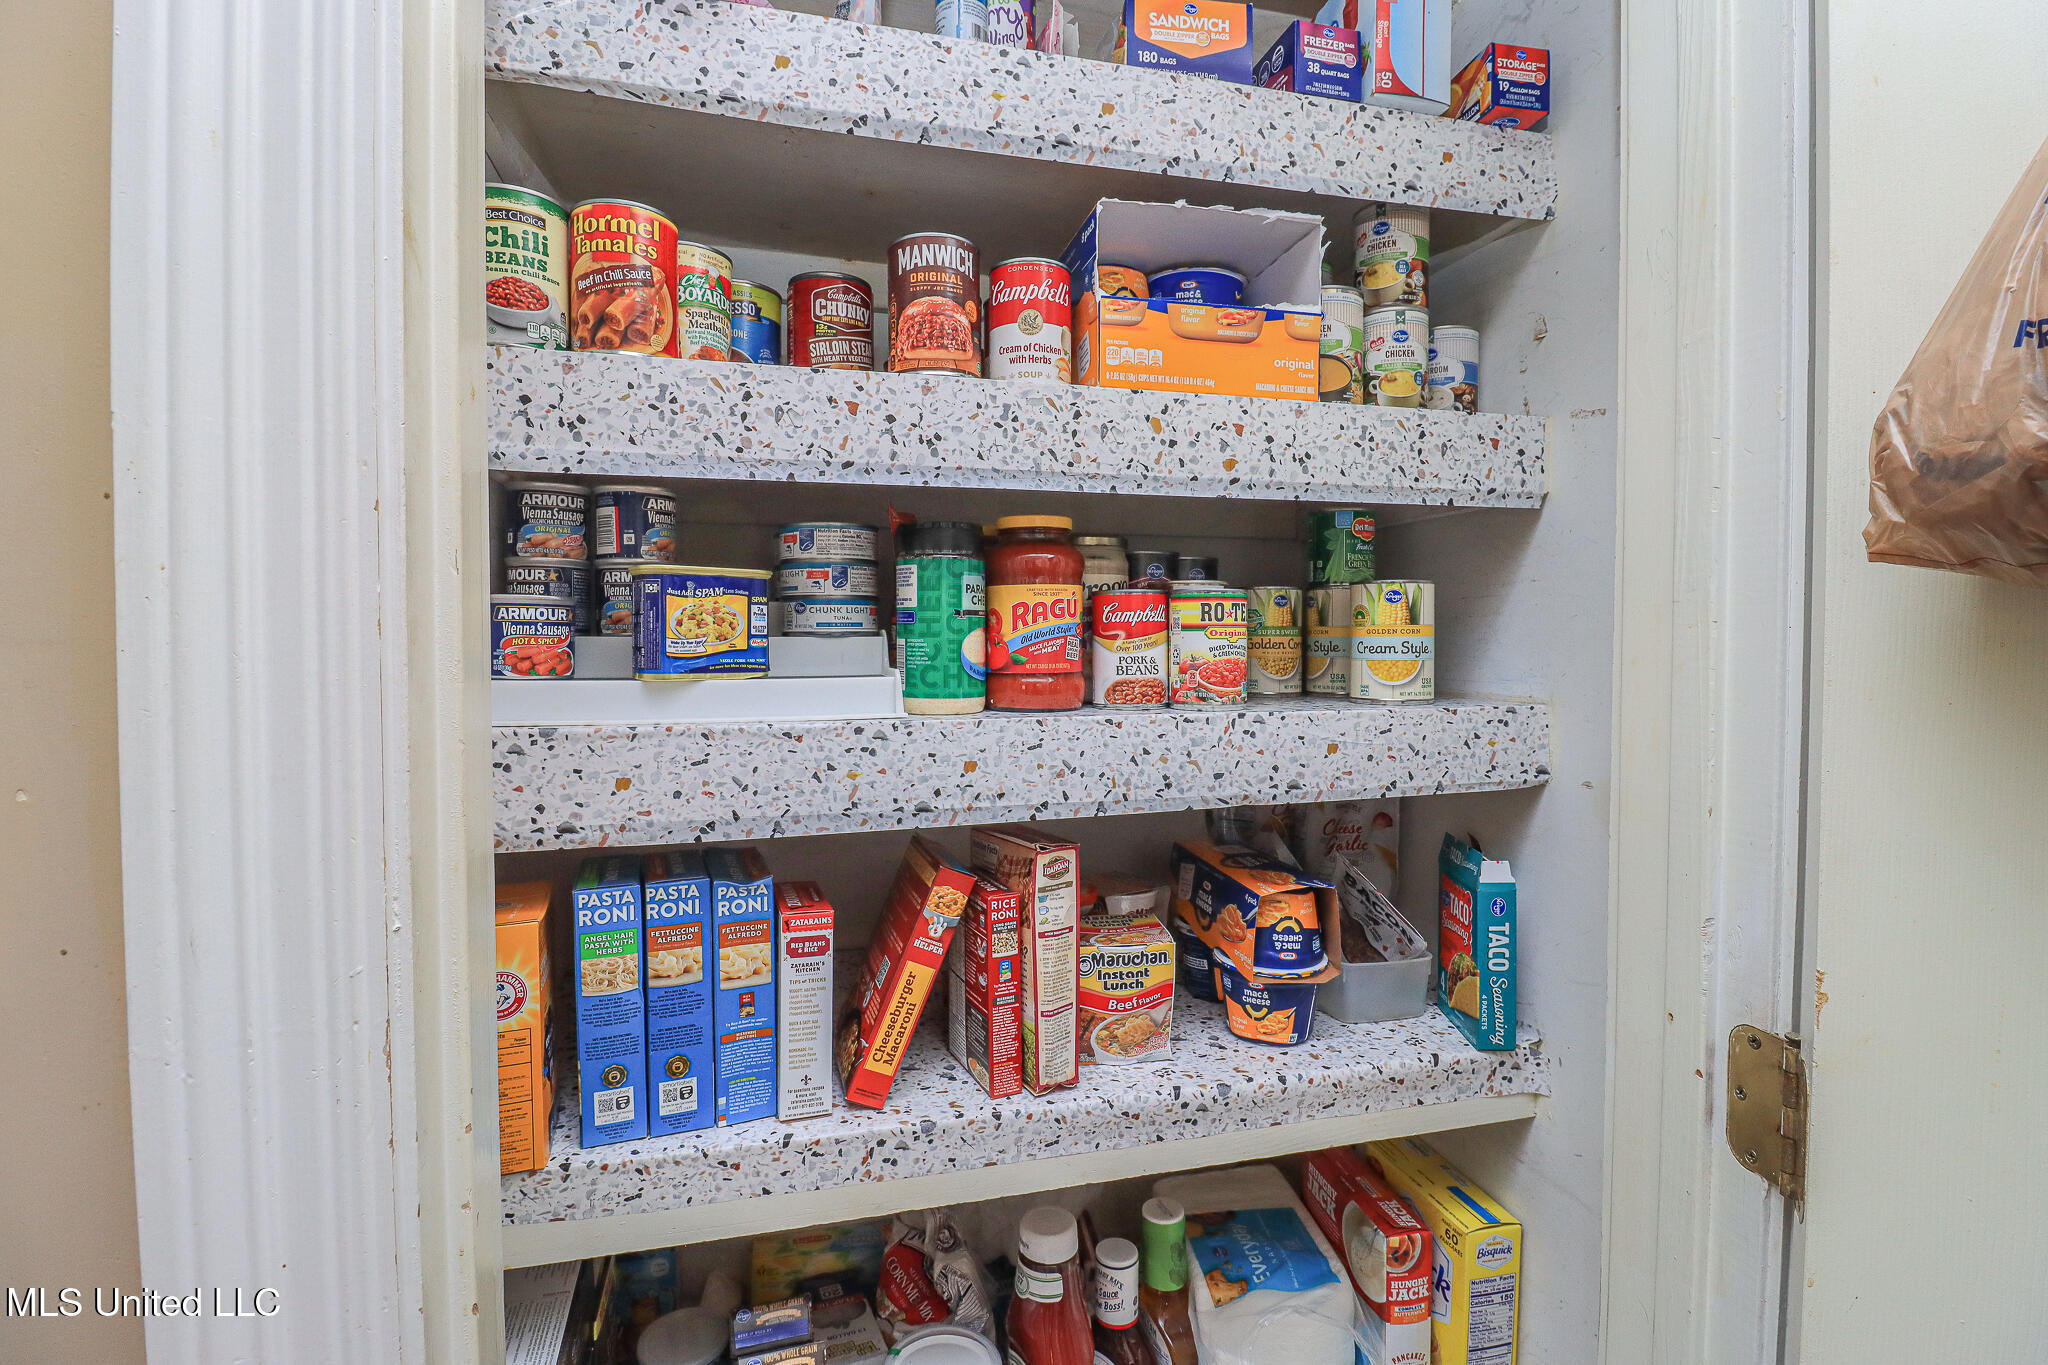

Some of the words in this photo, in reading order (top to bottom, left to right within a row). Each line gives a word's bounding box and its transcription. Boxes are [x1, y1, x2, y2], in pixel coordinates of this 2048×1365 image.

[1149, 12, 1230, 32] SANDWICH
[1304, 35, 1345, 51] FREEZER
[1138, 51, 1158, 63] 180
[1160, 57, 1177, 65] BAGS
[1497, 58, 1537, 71] STORAGE
[1307, 61, 1320, 74] 38
[1381, 71, 1392, 88] 50
[1498, 81, 1509, 91] 19
[486, 209, 507, 219] Best
[508, 210, 544, 227] Choice
[573, 213, 660, 242] Hormel
[486, 226, 549, 257] Chili
[575, 235, 658, 260] Tamales
[1367, 239, 1397, 253] CHICKEN
[486, 250, 548, 272] BEANS
[897, 243, 975, 279] MANWICH
[521, 270, 540, 280] Chili
[1007, 264, 1054, 273] CONDENSED
[577, 274, 595, 290] Beef
[595, 273, 603, 283] in
[603, 269, 623, 282] Chili
[625, 268, 651, 280] Sauce
[681, 274, 706, 286] Chef
[910, 272, 963, 285] ORIGINAL
[991, 278, 1069, 307] Campbell's
[815, 298, 870, 325] CHUNKY
[809, 341, 850, 357] SIRLOIN
[999, 344, 1021, 355] Cream
[1022, 343, 1032, 353] of
[1033, 343, 1062, 355] Chicken
[1385, 349, 1415, 358] CHICKEN
[1008, 355, 1026, 365] with
[1028, 354, 1052, 365] Herbs
[1274, 358, 1315, 371] original
[1017, 371, 1043, 379] SOUP
[522, 493, 584, 509] ARMOUR
[522, 506, 551, 520] Vienna
[552, 508, 584, 523] Sausage
[534, 525, 571, 534] ORIGINAL
[786, 569, 804, 578] LIGHT
[694, 587, 724, 598] SPAM
[1385, 591, 1403, 602] Kroger
[498, 608, 568, 621] ARMOUR
[1011, 591, 1078, 634] RAGÚ
[1102, 602, 1166, 626] Campbell's
[502, 621, 535, 636] Vienna
[535, 622, 570, 638] Sausage
[1021, 632, 1033, 644] Old
[1034, 627, 1056, 640] World
[1057, 625, 1073, 635] Style
[512, 637, 526, 646] HOT
[527, 637, 534, 645] &
[535, 636, 559, 646] SPICY
[1029, 642, 1043, 652] SAUCE
[1133, 643, 1142, 651] 100
[1248, 638, 1285, 650] Golden
[1042, 645, 1060, 654] MEAT
[1208, 644, 1227, 653] DICED
[1313, 640, 1339, 657] Style
[1357, 640, 1398, 654] Cream
[1401, 640, 1430, 658] Style
[1118, 656, 1148, 665] PORK
[1149, 656, 1156, 664] &
[1116, 665, 1159, 675] BEANS
[1189, 672, 1196, 680] 25
[1323, 818, 1362, 835] Cheese
[1044, 860, 1069, 874] IDAHOAN
[578, 890, 635, 908] PASTA
[646, 884, 700, 902] PASTA
[718, 884, 769, 900] PASTA
[646, 899, 701, 919] RONI
[718, 897, 769, 917] RONI
[991, 898, 1017, 910] RICE
[1344, 871, 1415, 947] BACON
[1450, 892, 1469, 926] TACO
[578, 905, 636, 927] RONI
[790, 916, 832, 926] ZATARAIN'S
[991, 910, 1017, 921] RONI
[651, 926, 699, 937] FETTUCCINE
[722, 923, 768, 934] FETTUCCINE
[727, 931, 762, 940] ALFREDO
[584, 934, 612, 943] ANGEL
[614, 931, 634, 940] HAIR
[584, 941, 611, 950] PASTA
[613, 938, 634, 947] WITH
[657, 934, 693, 943] ALFREDO
[596, 947, 623, 955] HERBS
[913, 939, 944, 955] HELPER
[1487, 922, 1510, 972] TACO
[1092, 951, 1170, 968] Maruchan
[1097, 968, 1150, 981] Instant
[1103, 979, 1145, 991] Lunch
[1107, 997, 1138, 1011] Beef
[1139, 992, 1162, 1006] Flavor
[872, 971, 917, 1063] Cheeseburger
[1489, 976, 1507, 1045] Seasoning
[883, 1001, 917, 1067] Macaroni
[1308, 1162, 1338, 1200] HUNGRY
[1306, 1174, 1337, 1222] JACK
[1445, 1228, 1459, 1246] 60
[1231, 1222, 1272, 1284] Everyday
[1439, 1235, 1463, 1258] PANCAKES
[1477, 1245, 1513, 1260] Bisquick
[1391, 1277, 1429, 1288] HUNGRY
[1471, 1278, 1497, 1286] Nutrition
[886, 1256, 907, 1286] CORN
[917, 1301, 934, 1323] MIX
[1098, 1287, 1119, 1298] Sauce
[1388, 1285, 1430, 1301] JACK
[1104, 1299, 1124, 1311] Boss!
[1398, 1304, 1423, 1312] COMPLETE
[1393, 1309, 1426, 1317] BUTTERMILK
[765, 1352, 781, 1363] 100%
[782, 1348, 799, 1359] WHOLE
[801, 1344, 818, 1356] GRAIN
[1392, 1352, 1425, 1364] PANCAKES
